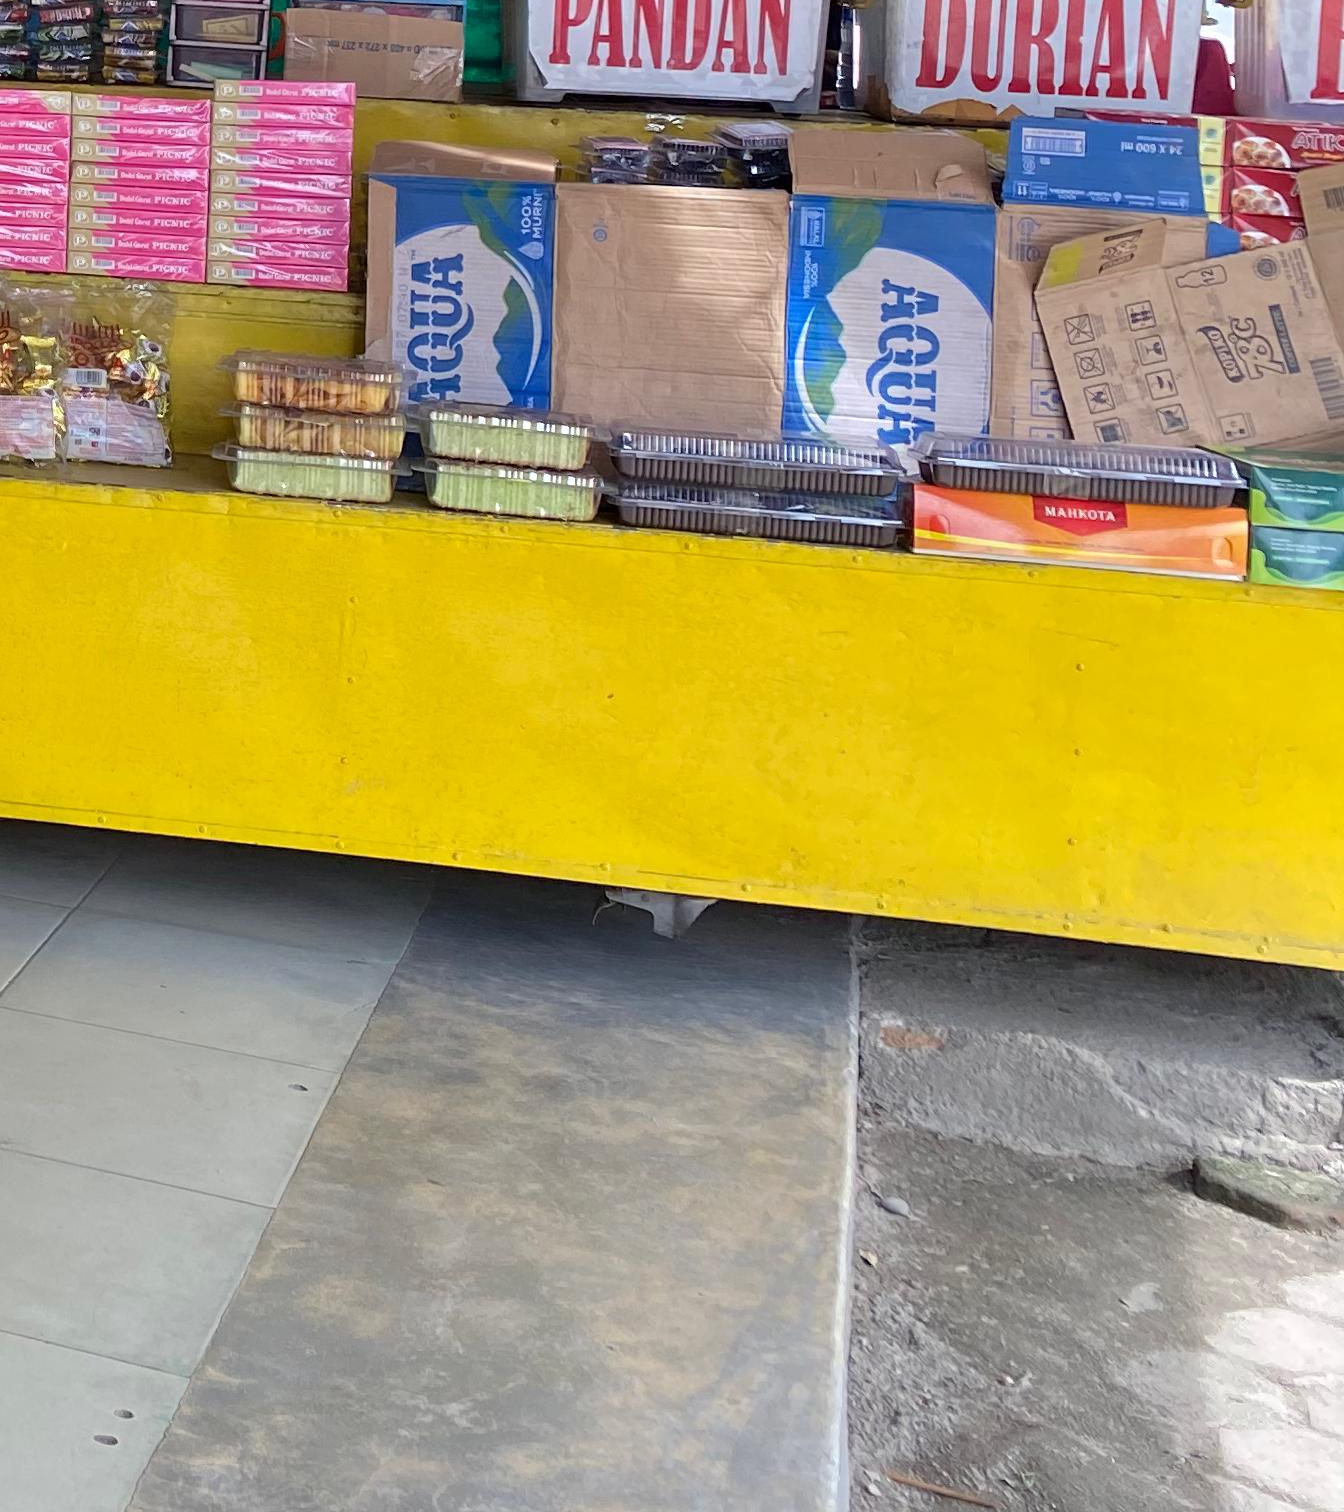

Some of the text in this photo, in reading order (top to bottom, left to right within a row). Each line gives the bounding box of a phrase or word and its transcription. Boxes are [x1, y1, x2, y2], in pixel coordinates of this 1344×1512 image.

[301, 88, 339, 98] PICNIC
[17, 143, 54, 153] PICNIC
[1135, 142, 1157, 154] 600
[156, 150, 193, 161] PICNIC
[297, 157, 336, 167] PICNIC
[154, 173, 192, 182] PICNIC
[154, 196, 192, 206] PICNIC
[296, 204, 334, 214] PICNIC
[15, 210, 52, 219] PICNIC
[521, 196, 531, 235] 100%
[532, 193, 544, 239] MURNI
[153, 219, 190, 229] PICNIC
[295, 227, 334, 236] PICNIC
[14, 232, 51, 242] PICNIC
[152, 242, 190, 252] PICNIC
[14, 255, 51, 265] PICNIC
[294, 250, 333, 260] PICNIC
[152, 264, 189, 274] PICNIC
[293, 273, 332, 283] PICNIC
[802, 250, 811, 300] INDONESIA
[1201, 268, 1215, 285] 12
[407, 252, 475, 403] AQUA
[1208, 329, 1242, 379] KOPIKO
[866, 278, 941, 447] AQUA
[1044, 504, 1117, 522] MAHKOTA
